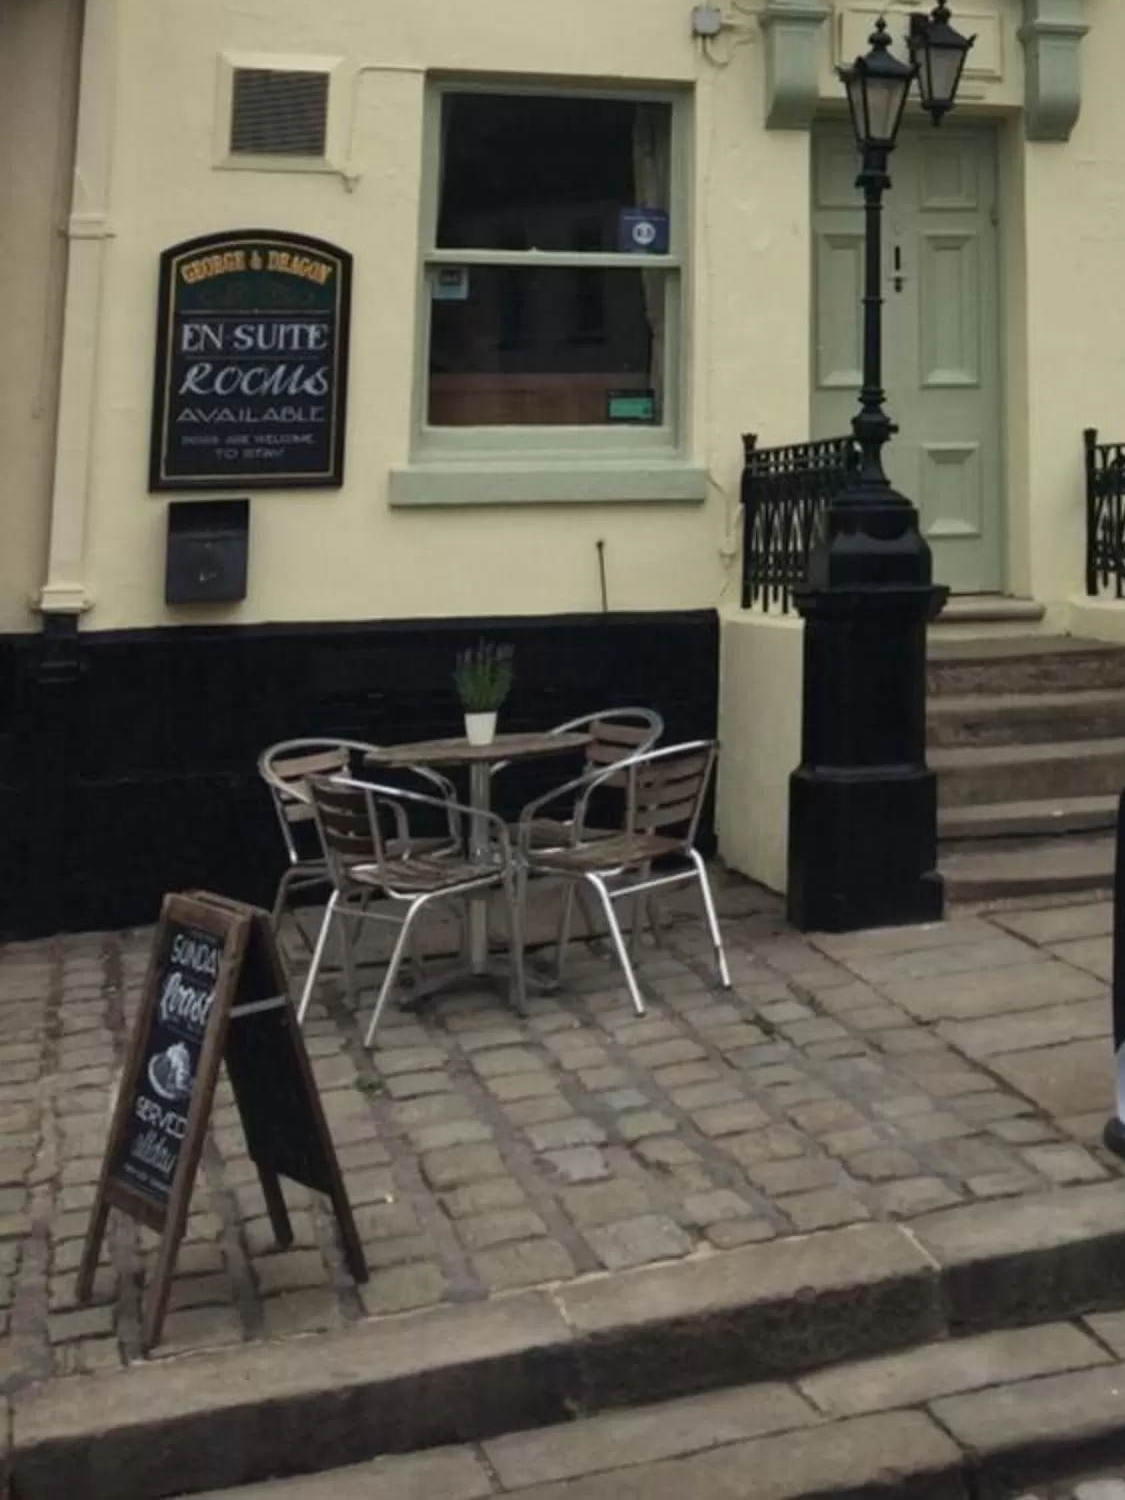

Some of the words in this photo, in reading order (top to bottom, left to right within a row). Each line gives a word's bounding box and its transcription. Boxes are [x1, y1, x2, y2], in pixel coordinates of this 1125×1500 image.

[180, 251, 247, 284] GEORGE
[267, 251, 332, 286] DRAGON
[176, 406, 325, 423] AVAILABLE
